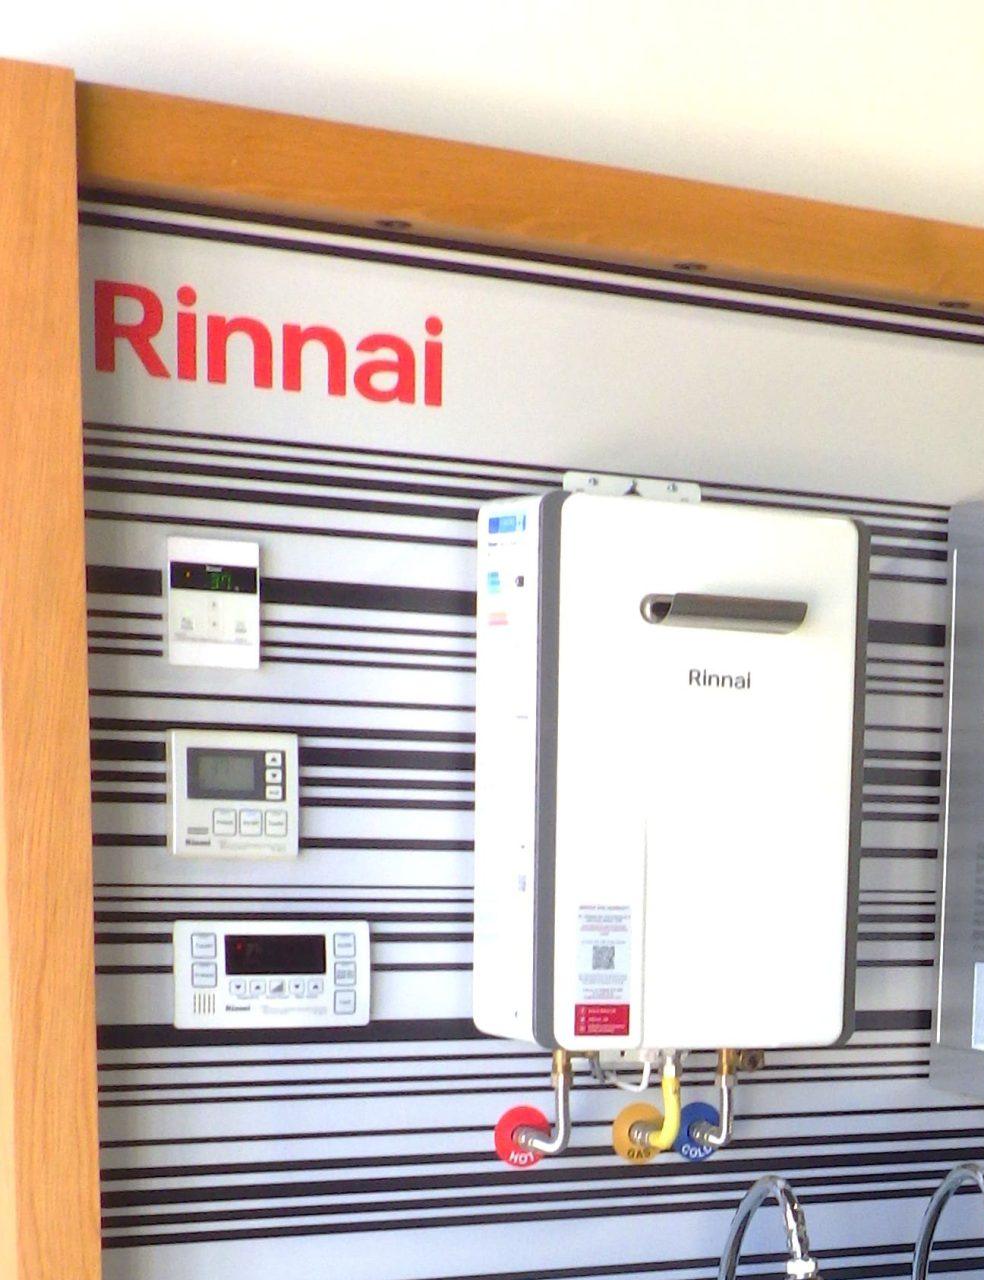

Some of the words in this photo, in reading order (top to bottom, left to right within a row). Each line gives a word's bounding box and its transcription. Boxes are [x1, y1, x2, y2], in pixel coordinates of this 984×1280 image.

[94, 280, 443, 406] Rinnai
[689, 668, 751, 689] Rinnai
[509, 1150, 535, 1165] HOT
[681, 1143, 713, 1159] COLD
